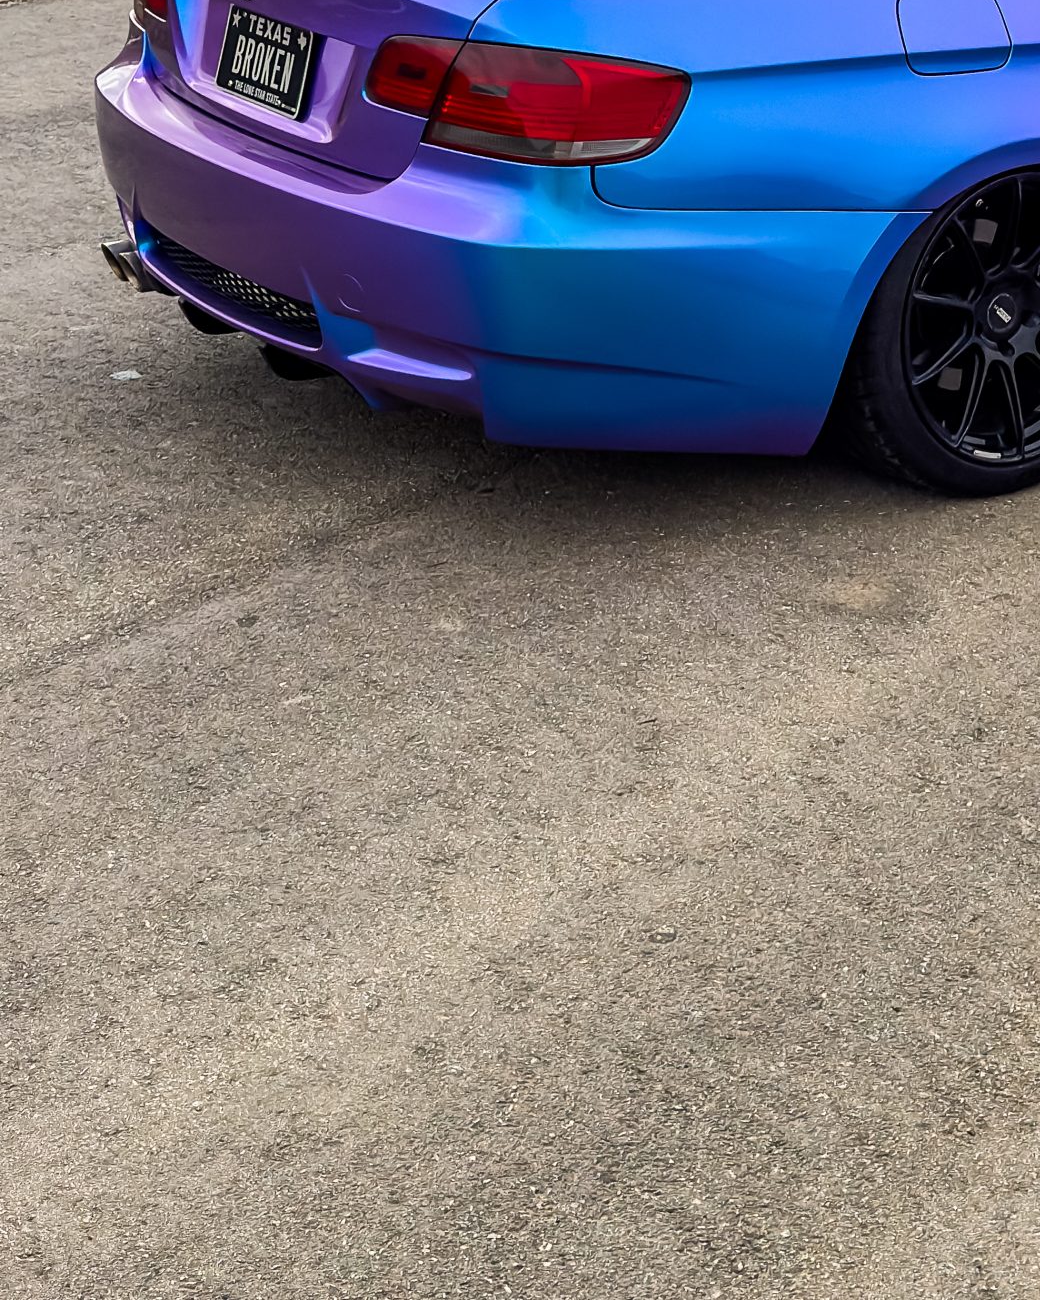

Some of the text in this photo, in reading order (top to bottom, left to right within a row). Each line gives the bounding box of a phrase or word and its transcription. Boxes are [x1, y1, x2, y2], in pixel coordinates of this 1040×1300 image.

[249, 13, 292, 46] TEXAS
[231, 34, 295, 94] BROKEN
[234, 80, 281, 106] THE LONE STAR STATE
